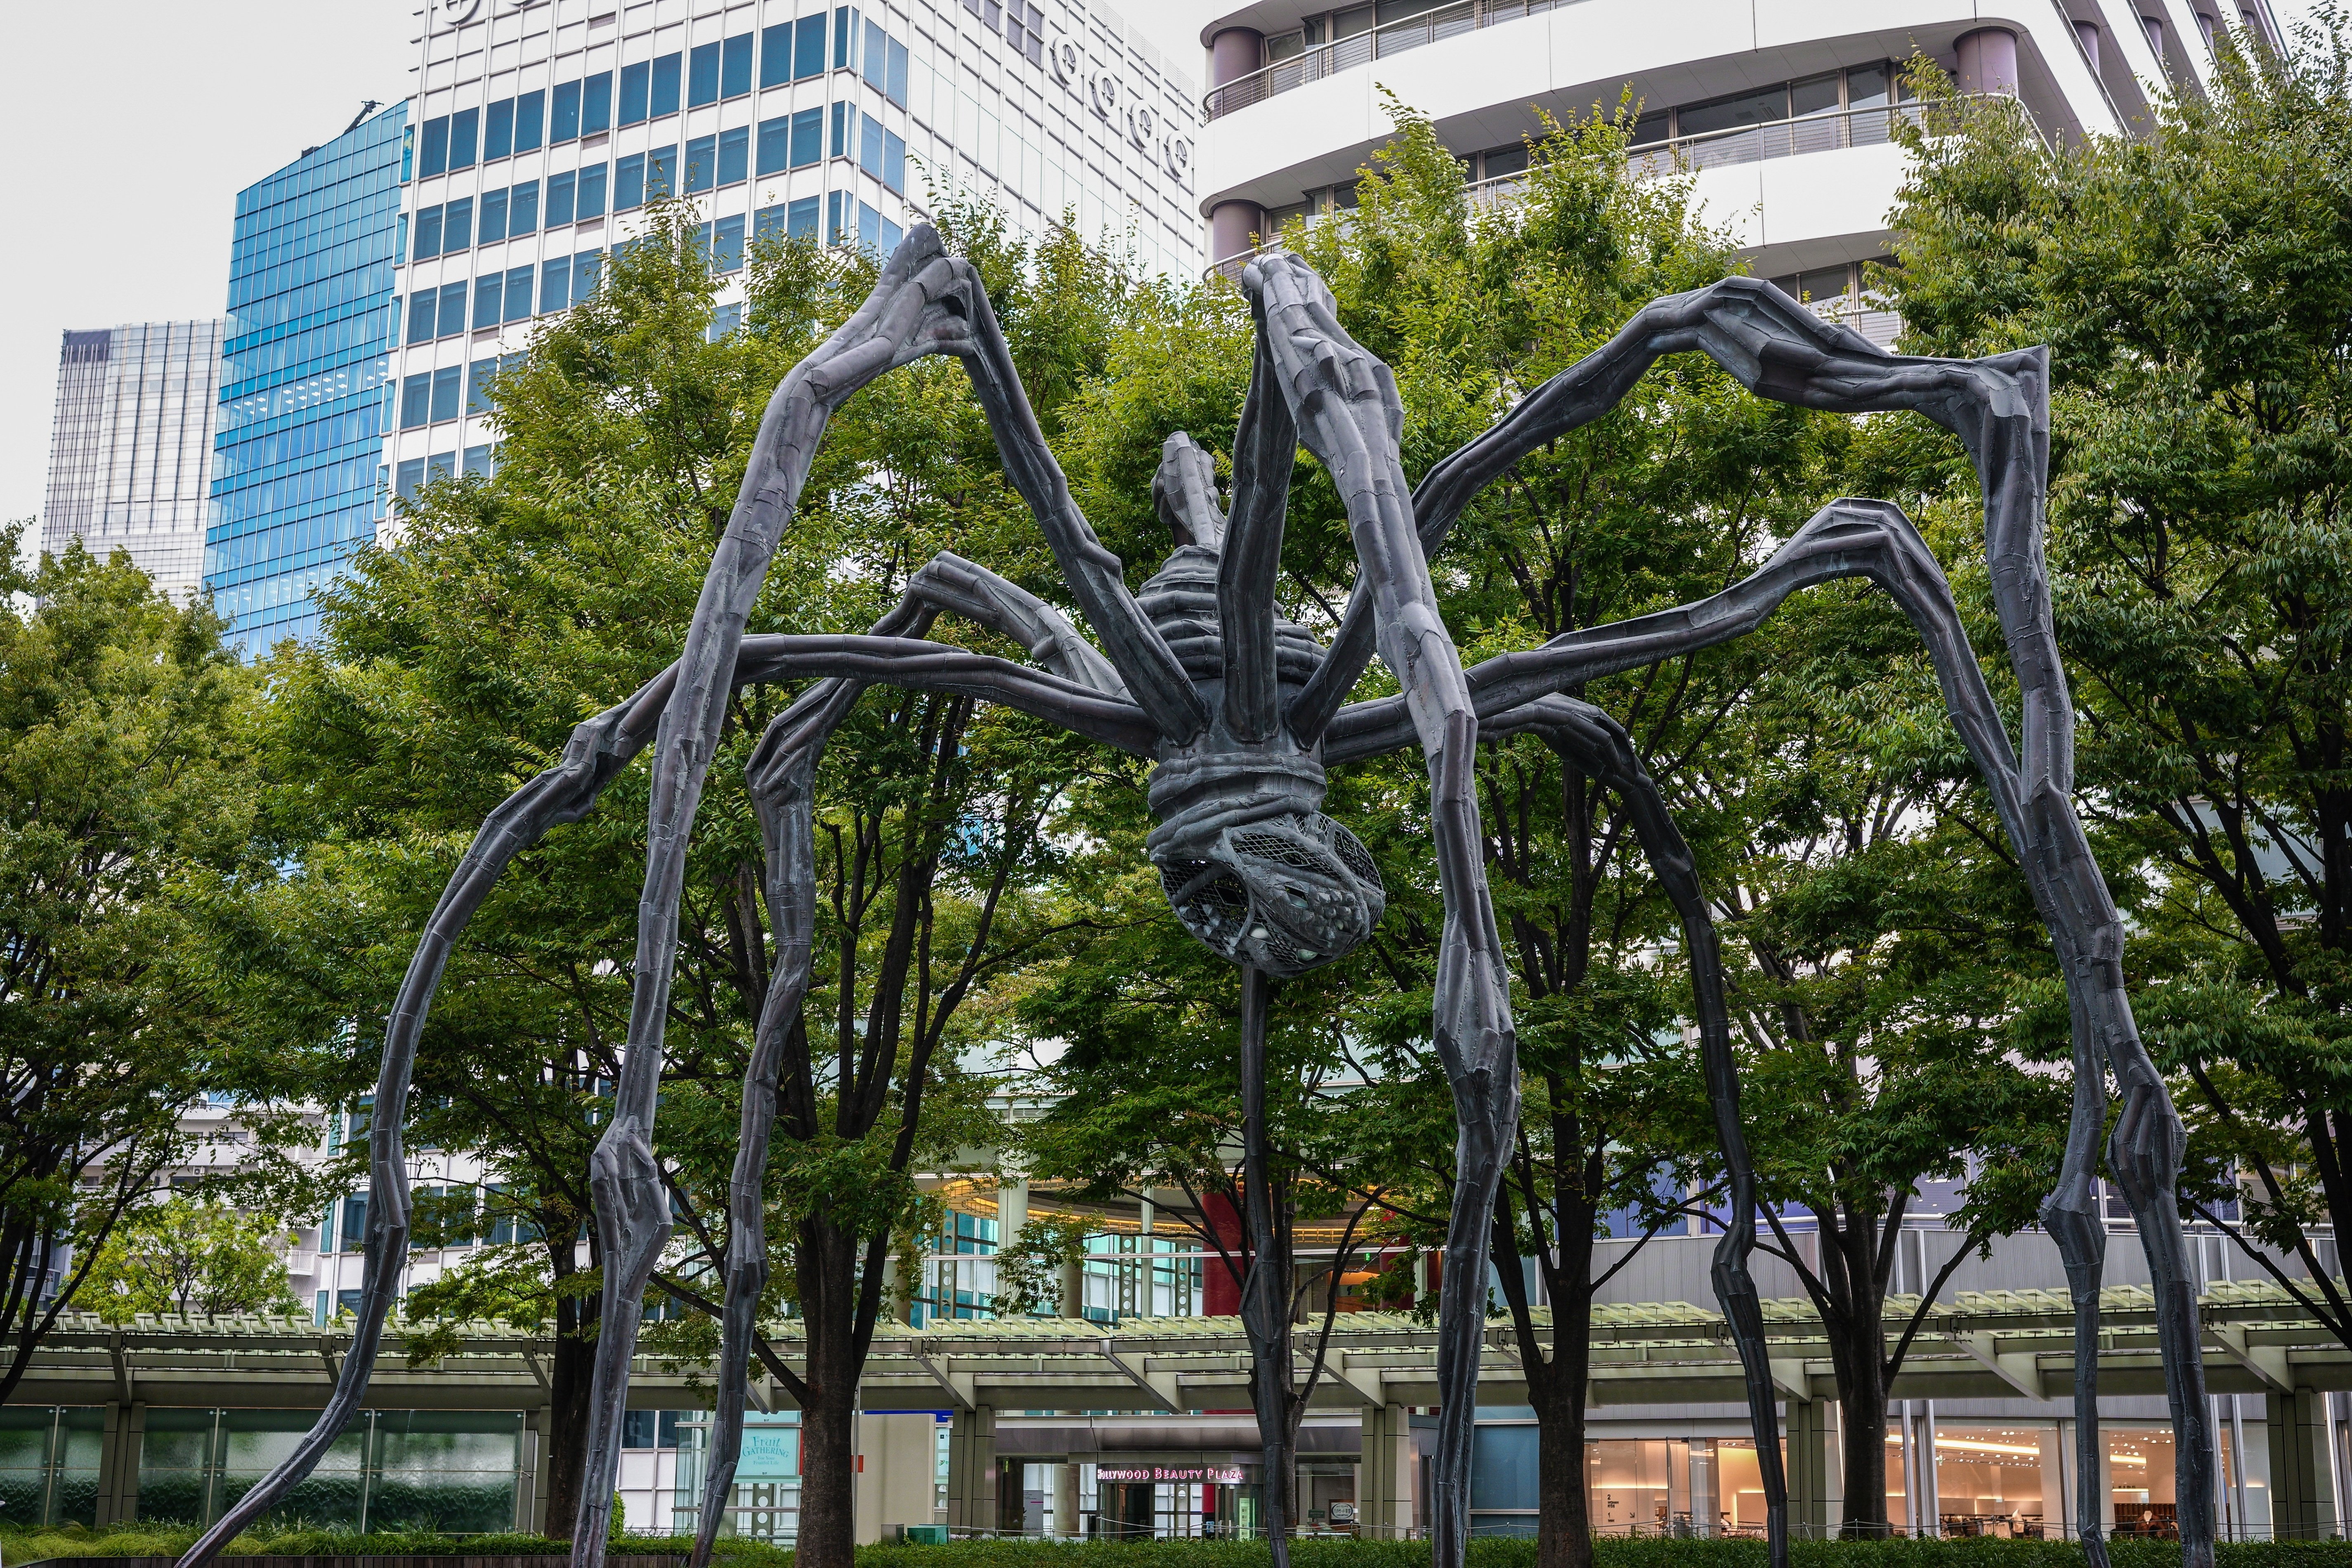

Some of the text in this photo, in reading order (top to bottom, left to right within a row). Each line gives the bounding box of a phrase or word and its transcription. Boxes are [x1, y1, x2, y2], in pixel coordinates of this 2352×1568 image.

[752, 1436, 780, 1448] Fruit
[743, 1446, 789, 1457] GATHERING
[1097, 1468, 1244, 1480] HOLLYWOOD BEAUTY PLAZA
